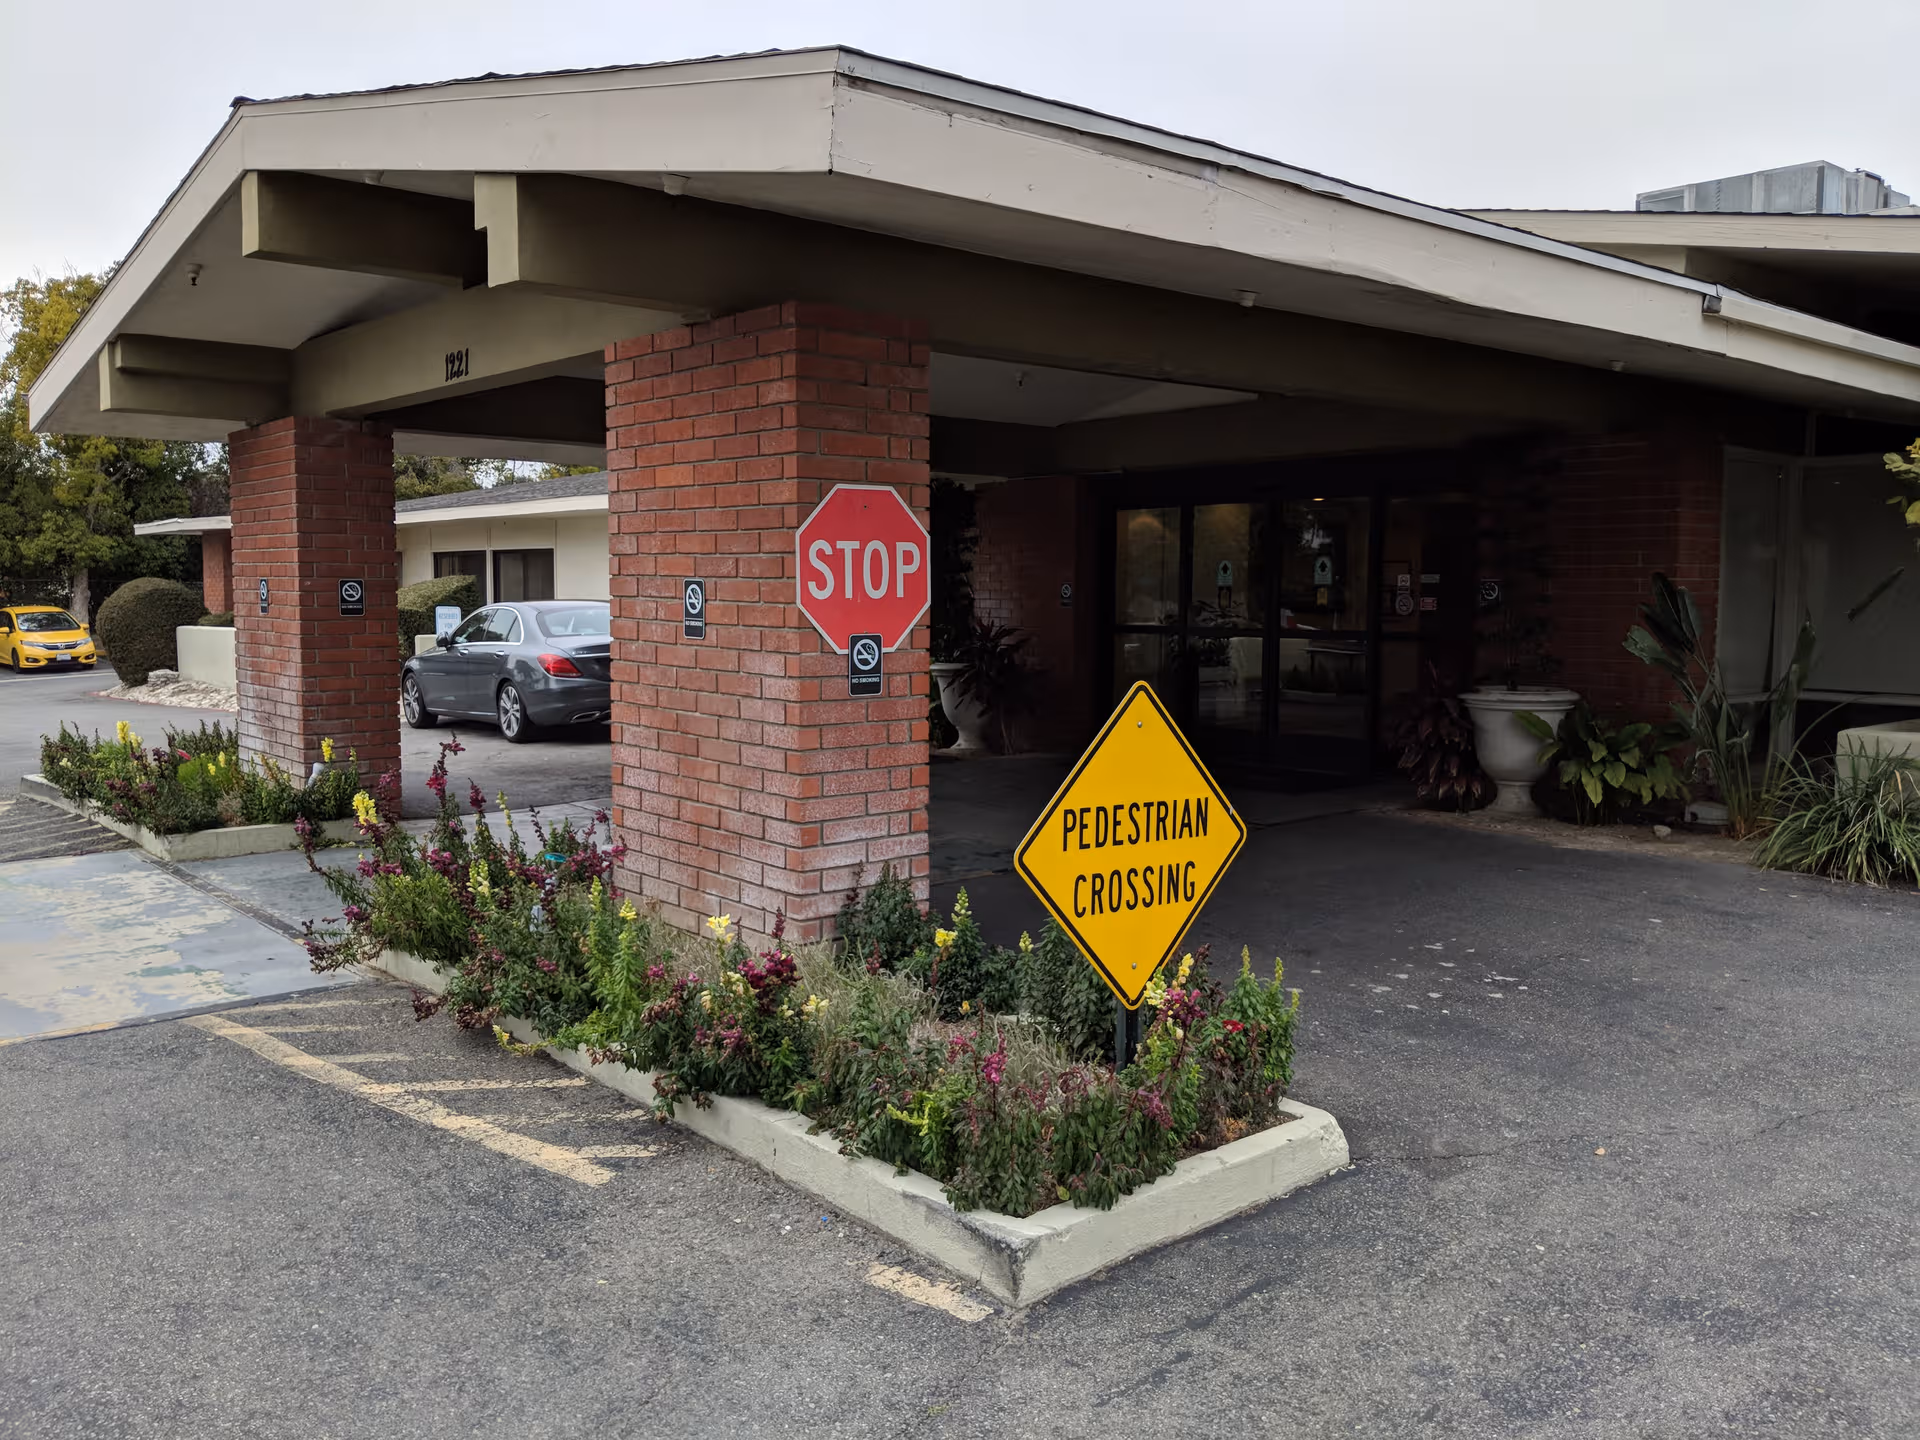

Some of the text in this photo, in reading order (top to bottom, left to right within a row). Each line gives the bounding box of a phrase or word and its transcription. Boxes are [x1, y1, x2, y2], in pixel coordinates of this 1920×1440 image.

[444, 347, 469, 382] 1221
[807, 539, 921, 600] STOP
[1062, 797, 1209, 852] PEDESTRIAN
[1073, 860, 1196, 918] CROSSING
